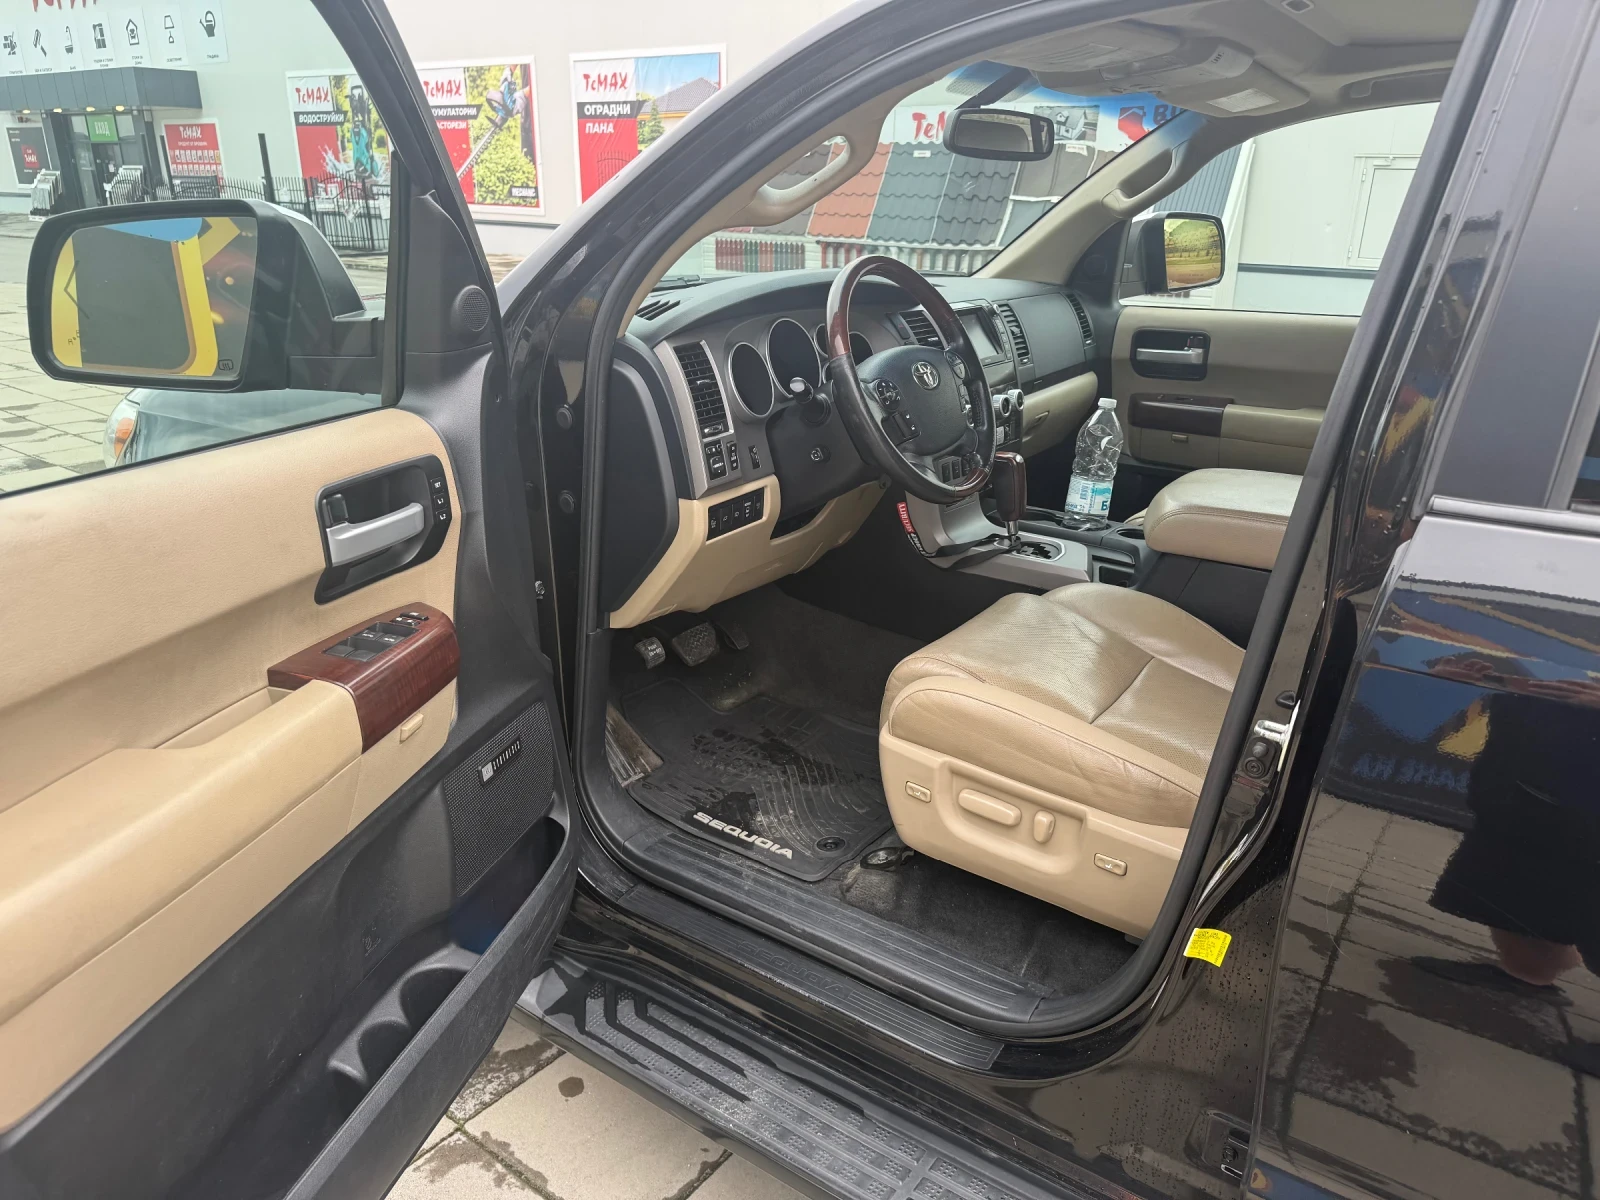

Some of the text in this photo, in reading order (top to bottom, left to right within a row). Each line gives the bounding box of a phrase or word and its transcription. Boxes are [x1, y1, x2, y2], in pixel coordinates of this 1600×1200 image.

[584, 103, 631, 117] ОГРАДНИ
[299, 111, 345, 125] ВОДОСТРУЙКИ
[94, 121, 111, 137] ВХОД
[585, 122, 615, 134] ПАНА
[692, 811, 793, 860] SEQUOIA
